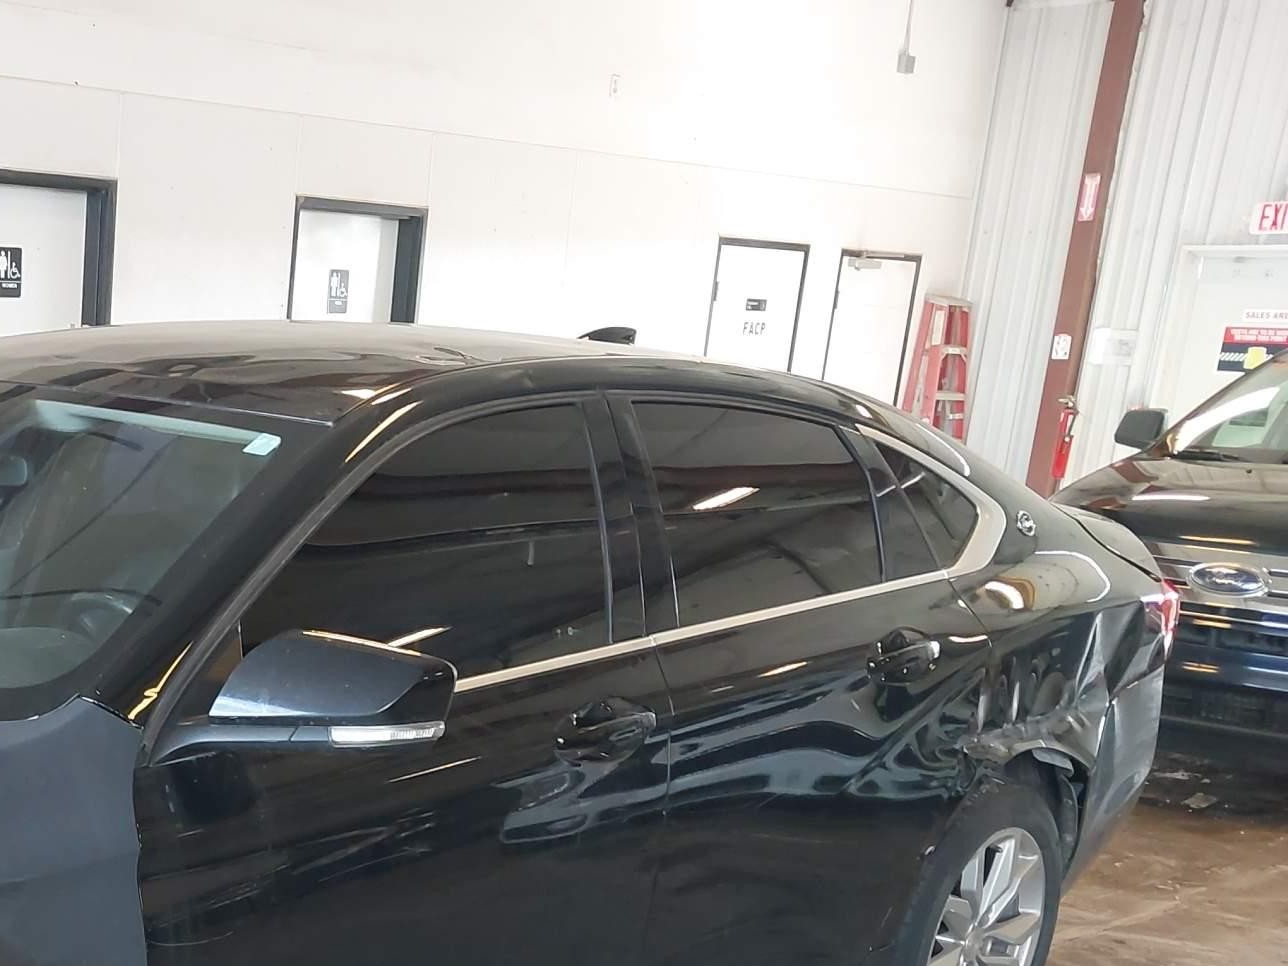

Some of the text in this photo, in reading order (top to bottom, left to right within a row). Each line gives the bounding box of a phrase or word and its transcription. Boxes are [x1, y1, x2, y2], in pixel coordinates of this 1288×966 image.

[1258, 203, 1288, 231] EXI
[1245, 311, 1271, 320] SALES
[743, 321, 766, 335] FACP
